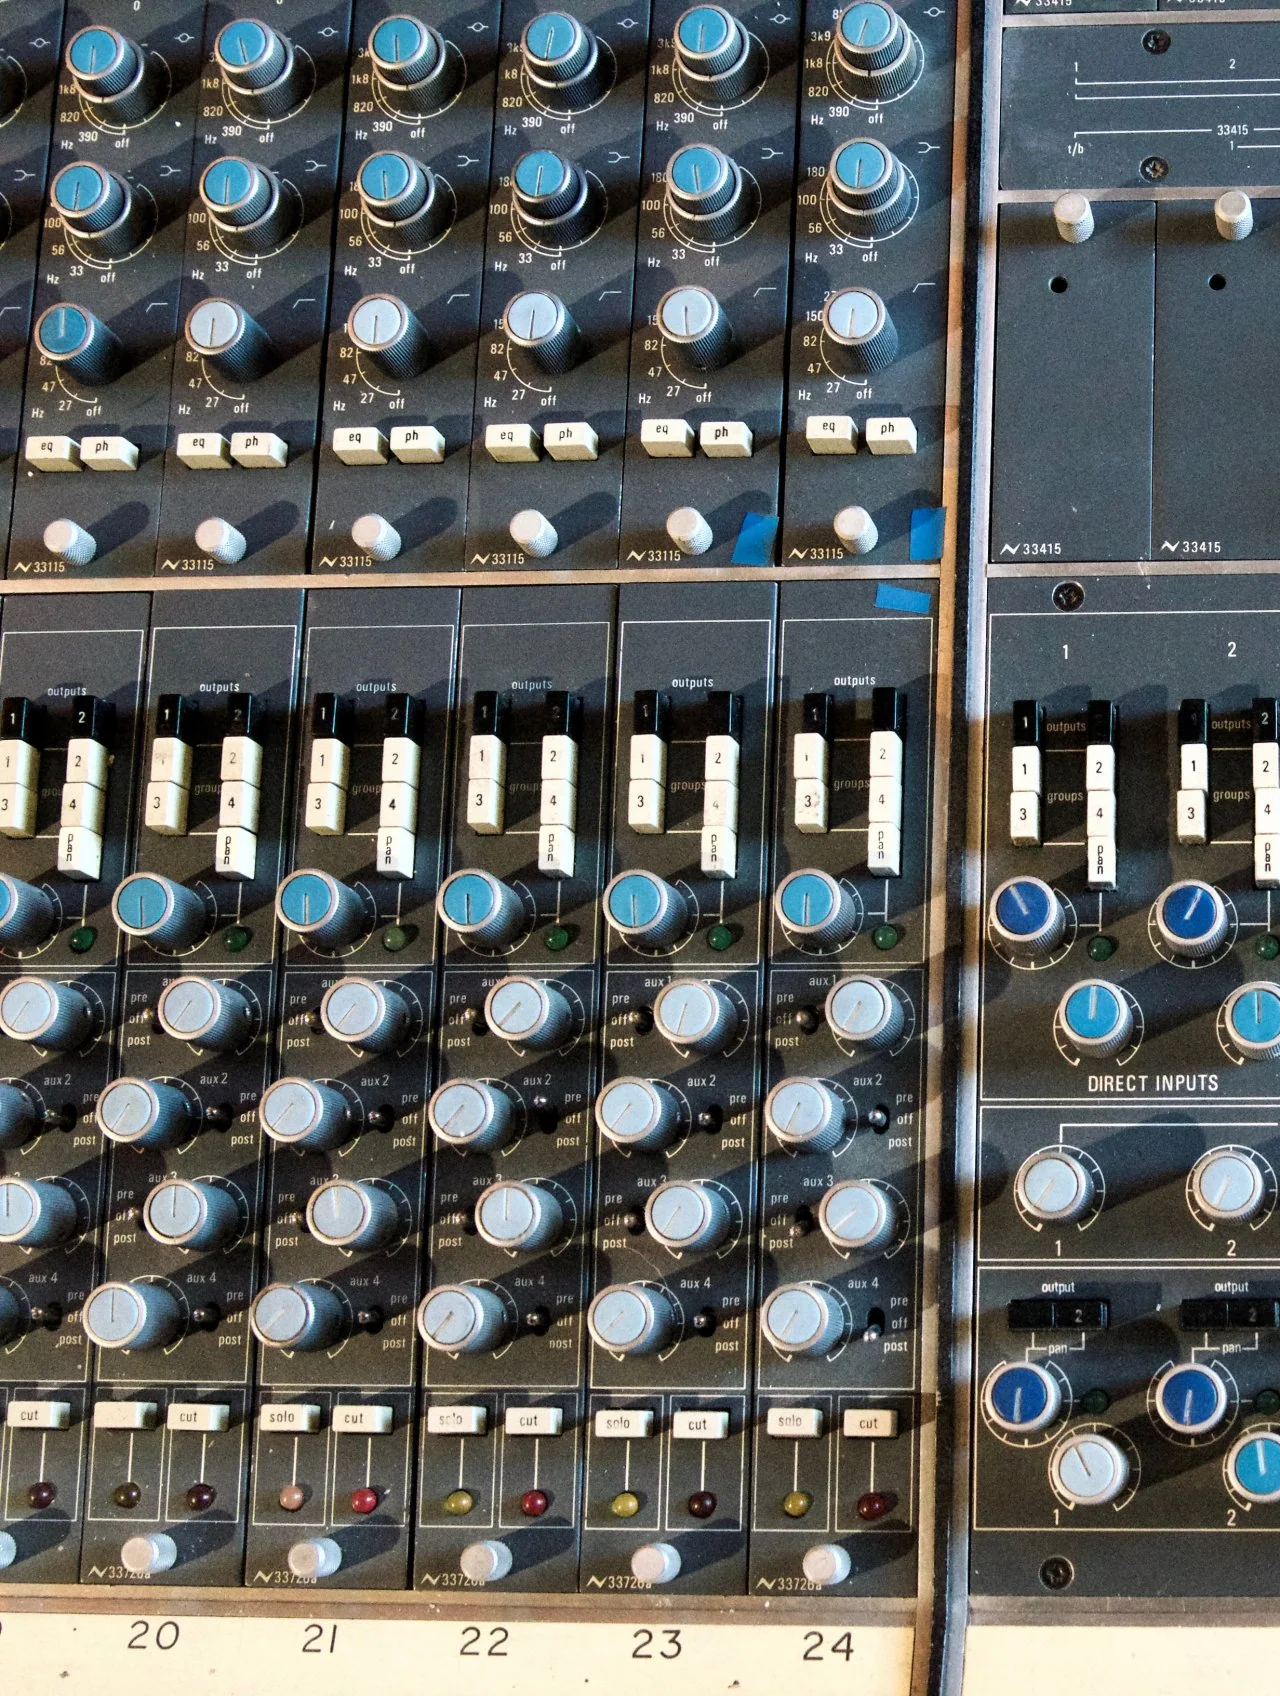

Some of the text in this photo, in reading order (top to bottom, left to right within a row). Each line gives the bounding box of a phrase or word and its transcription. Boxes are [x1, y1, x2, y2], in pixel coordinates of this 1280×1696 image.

[810, 31, 831, 43] 3k9
[804, 58, 823, 70] 1k8
[1229, 58, 1236, 70] 2
[808, 86, 829, 98] 820
[60, 110, 80, 123] 820
[828, 106, 850, 118] 390
[868, 111, 884, 124] off
[811, 114, 824, 125] Hz
[78, 130, 99, 143] 390
[1217, 124, 1249, 136] 33415
[114, 137, 130, 149] off
[1067, 142, 1084, 156] t/b
[826, 382, 841, 394] 27
[714, 426, 729, 439] ph
[822, 421, 835, 433] eq
[880, 421, 894, 435] ph
[41, 440, 53, 452] eq
[245, 435, 259, 448] ph
[810, 547, 844, 560] 33115
[1022, 542, 1062, 556] 33415
[1182, 541, 1221, 554] 33415
[491, 553, 525, 565] 33115
[647, 550, 681, 563] 33115
[33, 561, 65, 573] 33115
[182, 558, 214, 571] 33115
[1227, 641, 1237, 658] 2
[671, 676, 714, 689] outputs
[833, 674, 876, 687] outputs
[47, 685, 87, 698] outputs
[1046, 720, 1087, 733] outputs
[1211, 717, 1251, 730] outputs
[1047, 789, 1084, 803] groups
[1213, 787, 1250, 802] groups
[852, 1074, 883, 1086] aux 2
[1087, 1074, 1219, 1093] DIRECT INPUTS
[895, 1092, 913, 1105] pre
[896, 1113, 913, 1125] off
[888, 1135, 913, 1149] post
[1226, 1240, 1237, 1257] 2
[847, 1278, 879, 1290] aux 4
[1041, 1281, 1075, 1295] output
[1214, 1280, 1249, 1294] output
[218, 1333, 242, 1348] post
[883, 1339, 908, 1354] post
[1048, 1342, 1068, 1356] pan
[1221, 1341, 1242, 1354] pan
[20, 1409, 39, 1421] cut
[269, 1410, 295, 1423] solo
[519, 1415, 538, 1427] cut
[688, 1418, 707, 1430] cut
[859, 1417, 878, 1429] cut
[1053, 1509, 1060, 1526] 1
[1226, 1509, 1237, 1526] 2
[128, 1621, 180, 1650] 20
[302, 1624, 337, 1654] 21
[460, 1626, 509, 1657] 22
[631, 1630, 683, 1659] 23
[802, 1631, 854, 1661] 24
